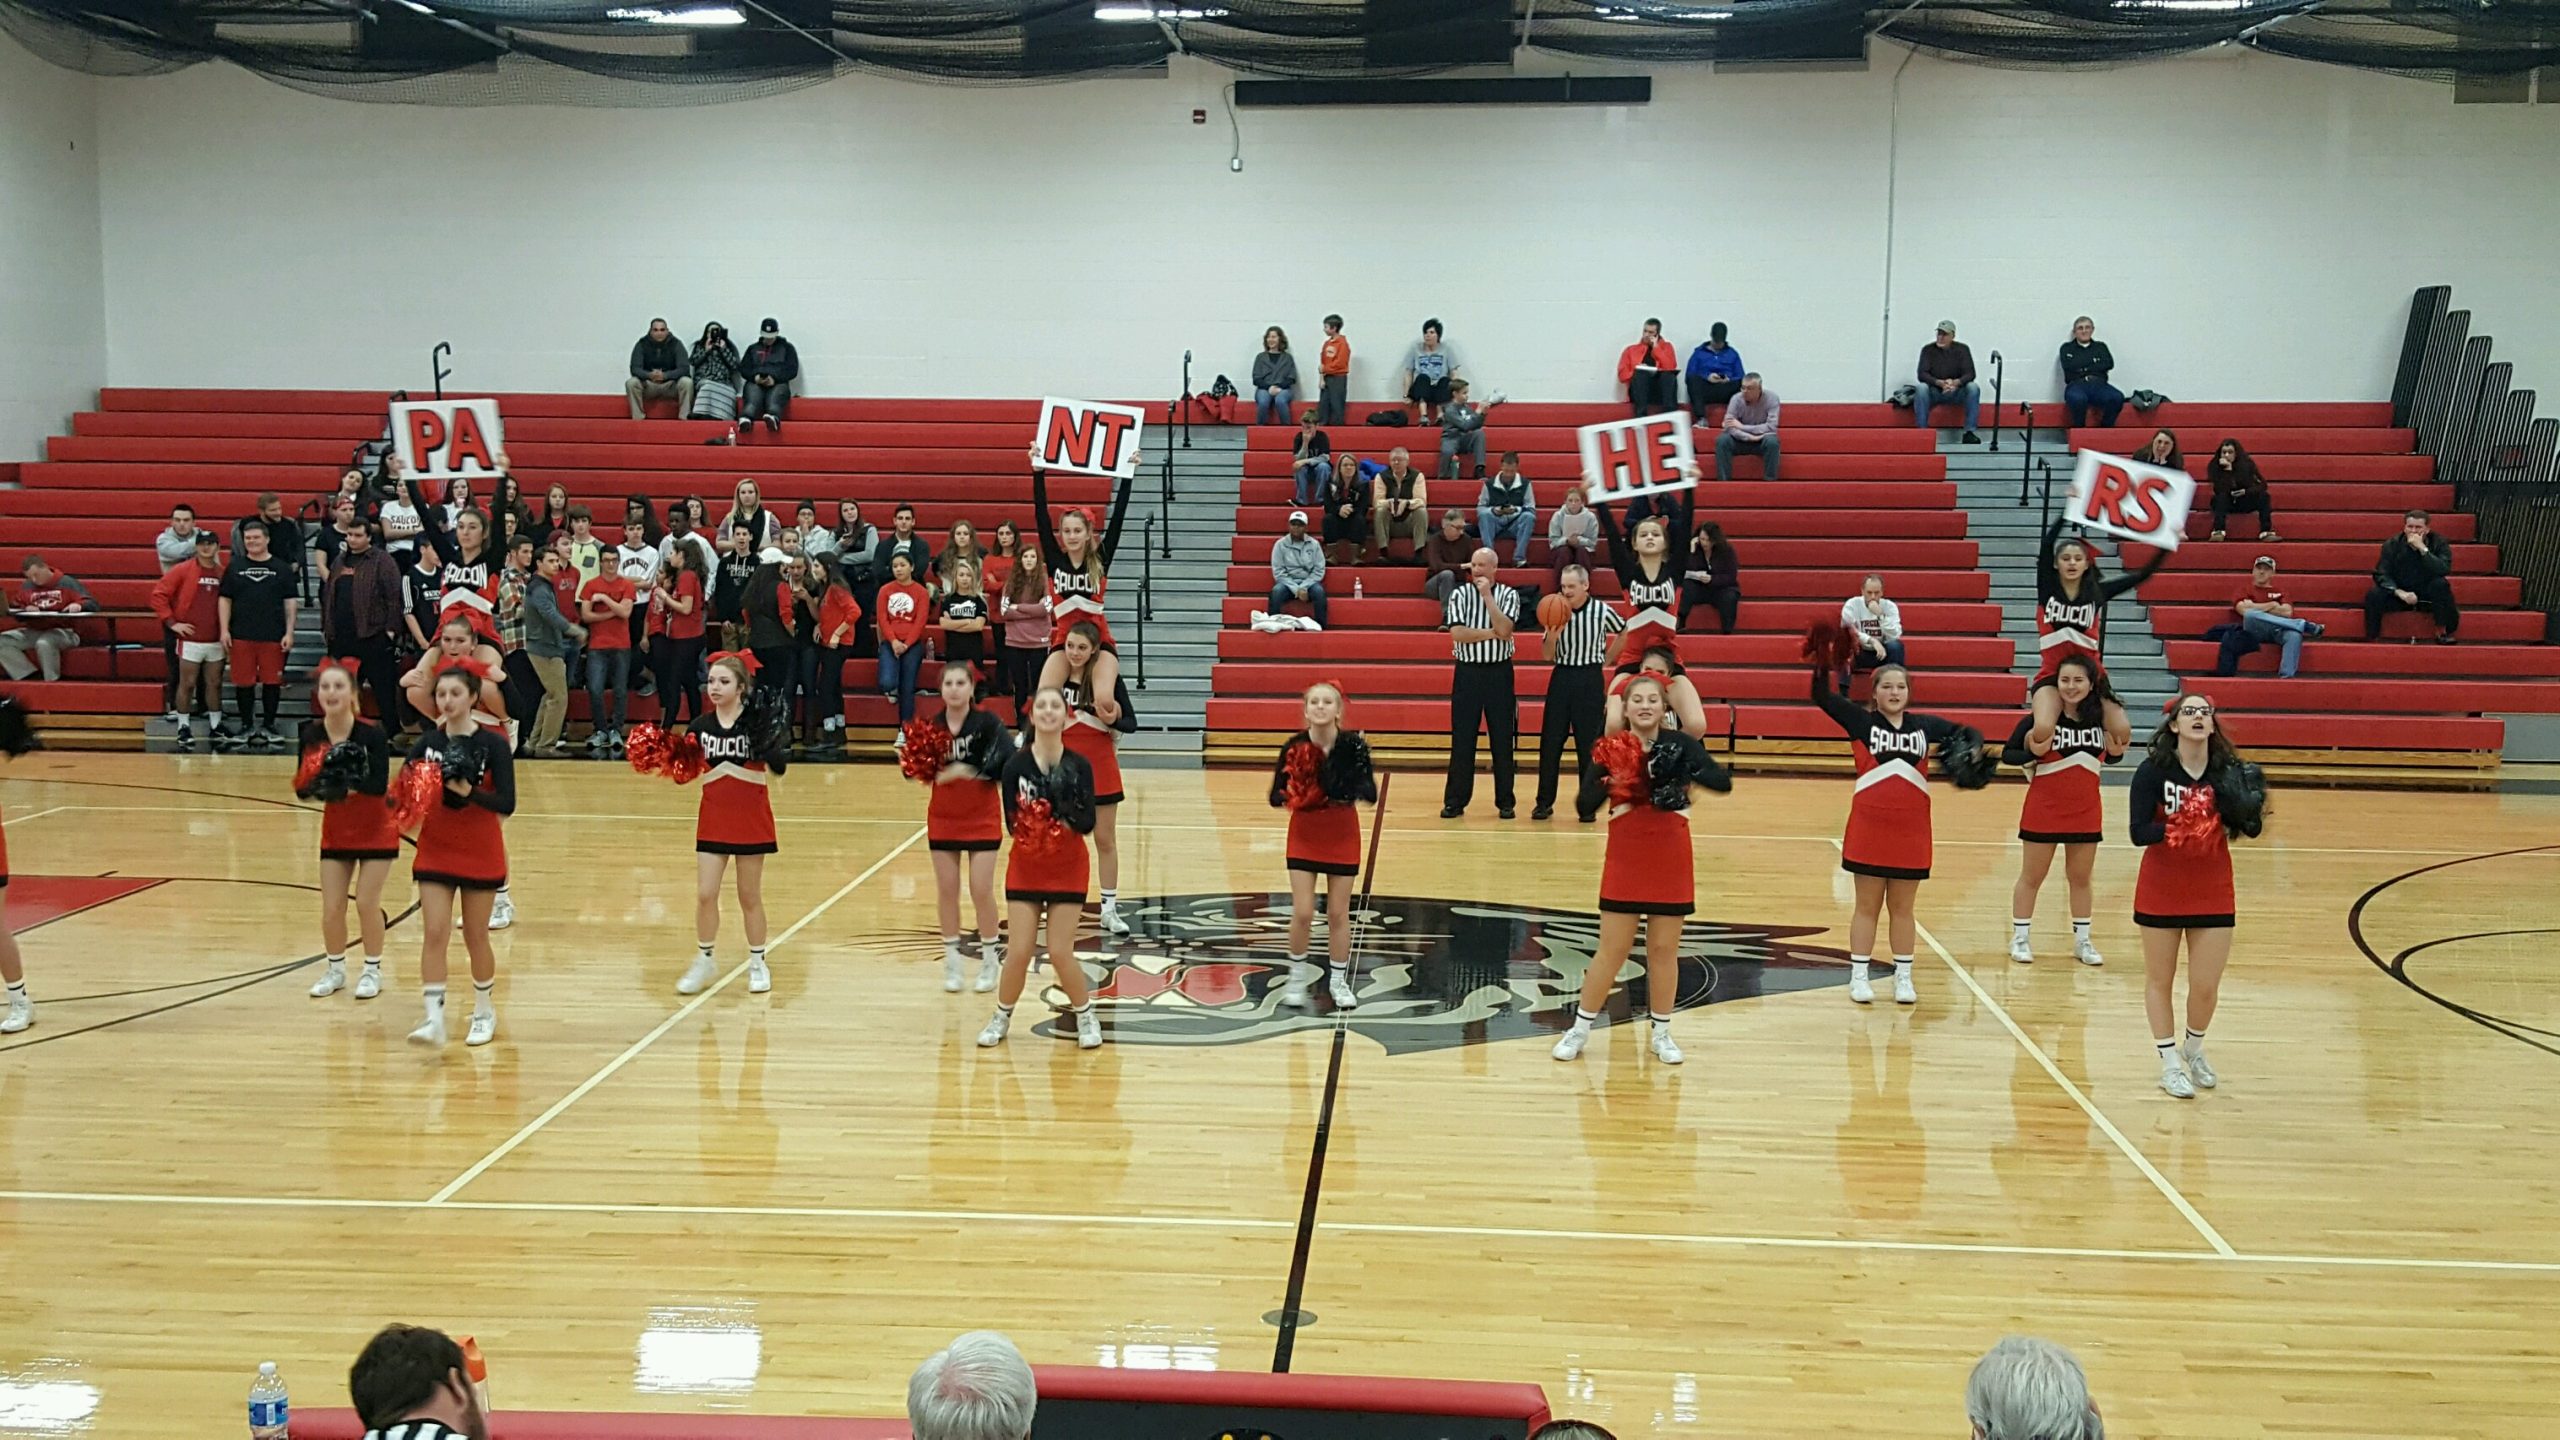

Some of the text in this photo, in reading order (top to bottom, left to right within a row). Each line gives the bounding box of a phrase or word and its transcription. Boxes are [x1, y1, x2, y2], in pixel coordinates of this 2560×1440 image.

[407, 407, 495, 474] PA
[1044, 405, 1136, 471] NT
[1596, 421, 1683, 492] HE
[2086, 462, 2171, 533] RS
[445, 561, 488, 590] SAUCON
[1630, 577, 1675, 606] SAUCON
[2044, 596, 2096, 629] SAUCON
[1869, 725, 1926, 760] SAUCON
